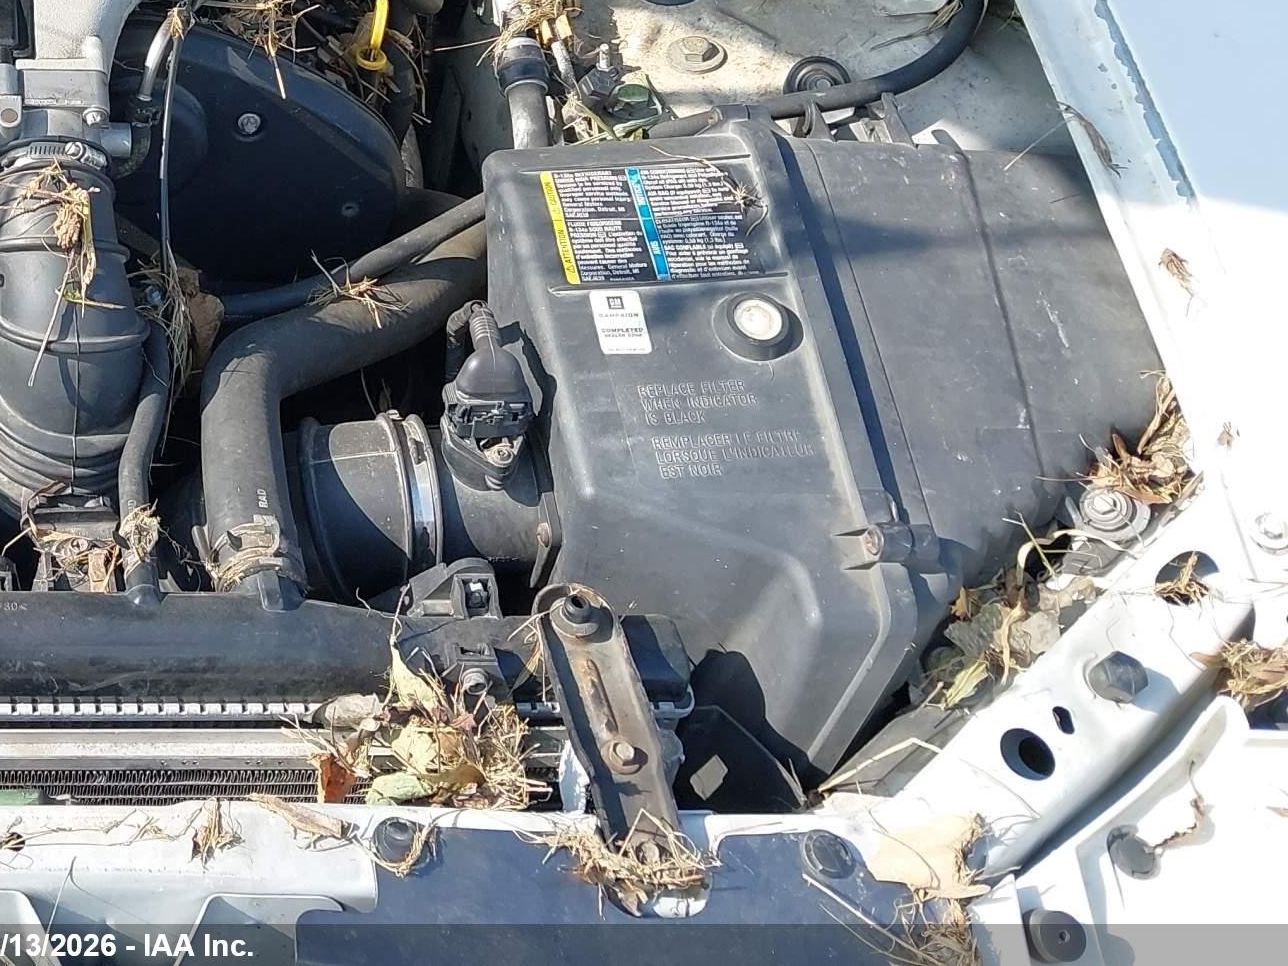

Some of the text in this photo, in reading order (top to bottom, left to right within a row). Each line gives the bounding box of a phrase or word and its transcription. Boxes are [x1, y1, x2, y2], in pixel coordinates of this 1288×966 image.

[544, 182, 558, 206] CAUTION
[558, 230, 571, 264] ATTENTION
[650, 240, 660, 254] AVIS
[638, 379, 745, 398] REPLACE FILTER
[641, 392, 757, 412] WHEN INDICATOR
[646, 410, 706, 426] IS BLACK
[652, 433, 732, 450] REMPLACER
[656, 448, 719, 465] LORSQUE
[659, 462, 723, 479] EST NOIR
[256, 488, 269, 508] RAD
